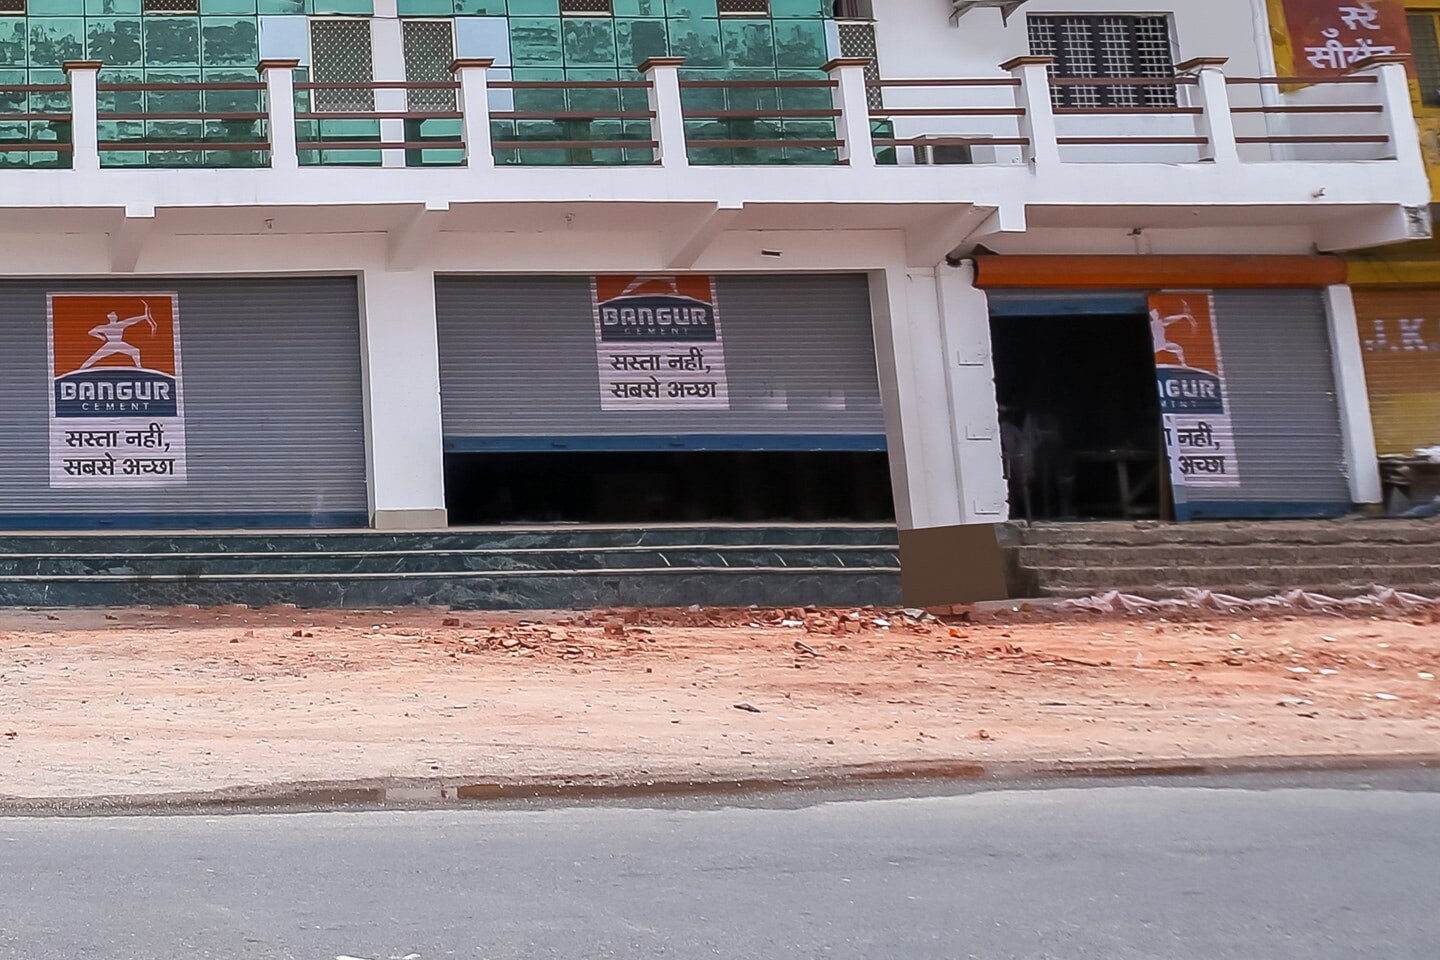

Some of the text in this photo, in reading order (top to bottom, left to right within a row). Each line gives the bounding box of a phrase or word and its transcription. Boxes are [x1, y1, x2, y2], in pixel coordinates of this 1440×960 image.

[602, 307, 708, 326] BANGUR
[610, 346, 711, 373] सस्ता नहीं,
[60, 381, 171, 401] BANGUR
[611, 376, 717, 398] सबसे अच्छा
[1158, 379, 1217, 398] GUR
[81, 402, 150, 411] CEMENT
[65, 422, 170, 452] सस्ता नहीं,
[63, 452, 175, 476] सबसे अच्छा
[1178, 455, 1225, 474] अच्छा
